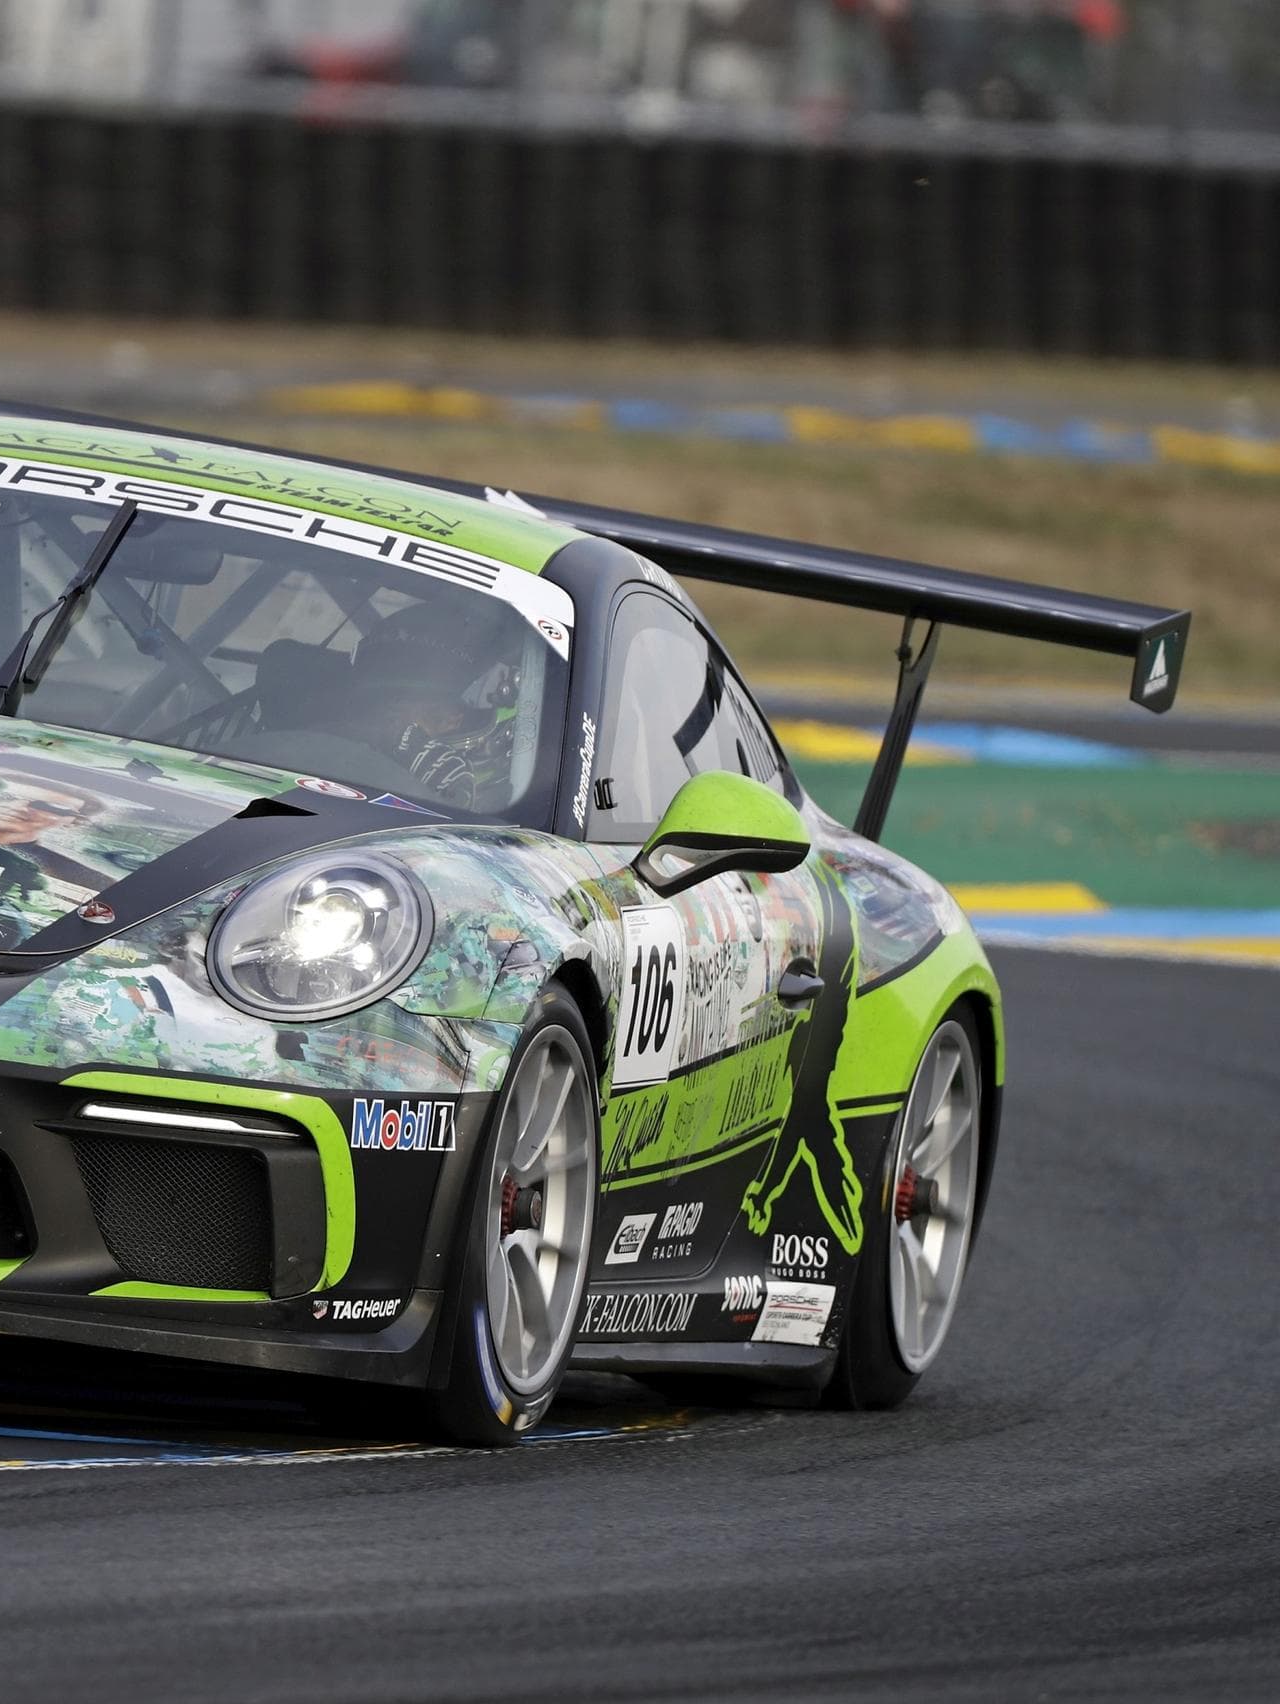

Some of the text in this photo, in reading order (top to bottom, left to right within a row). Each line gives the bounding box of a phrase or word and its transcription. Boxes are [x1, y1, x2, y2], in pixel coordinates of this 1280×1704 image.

[202, 461, 462, 529] FALCON
[623, 941, 677, 1058] 106
[351, 1098, 432, 1150] Mobil
[667, 1202, 704, 1238] PAGID
[651, 1242, 692, 1260] RACING
[771, 1233, 829, 1268] BOSS
[770, 1267, 826, 1280] HUGO BOSS
[578, 1292, 699, 1333] K-FALCON.COM
[770, 1294, 820, 1306] PORSCHE
